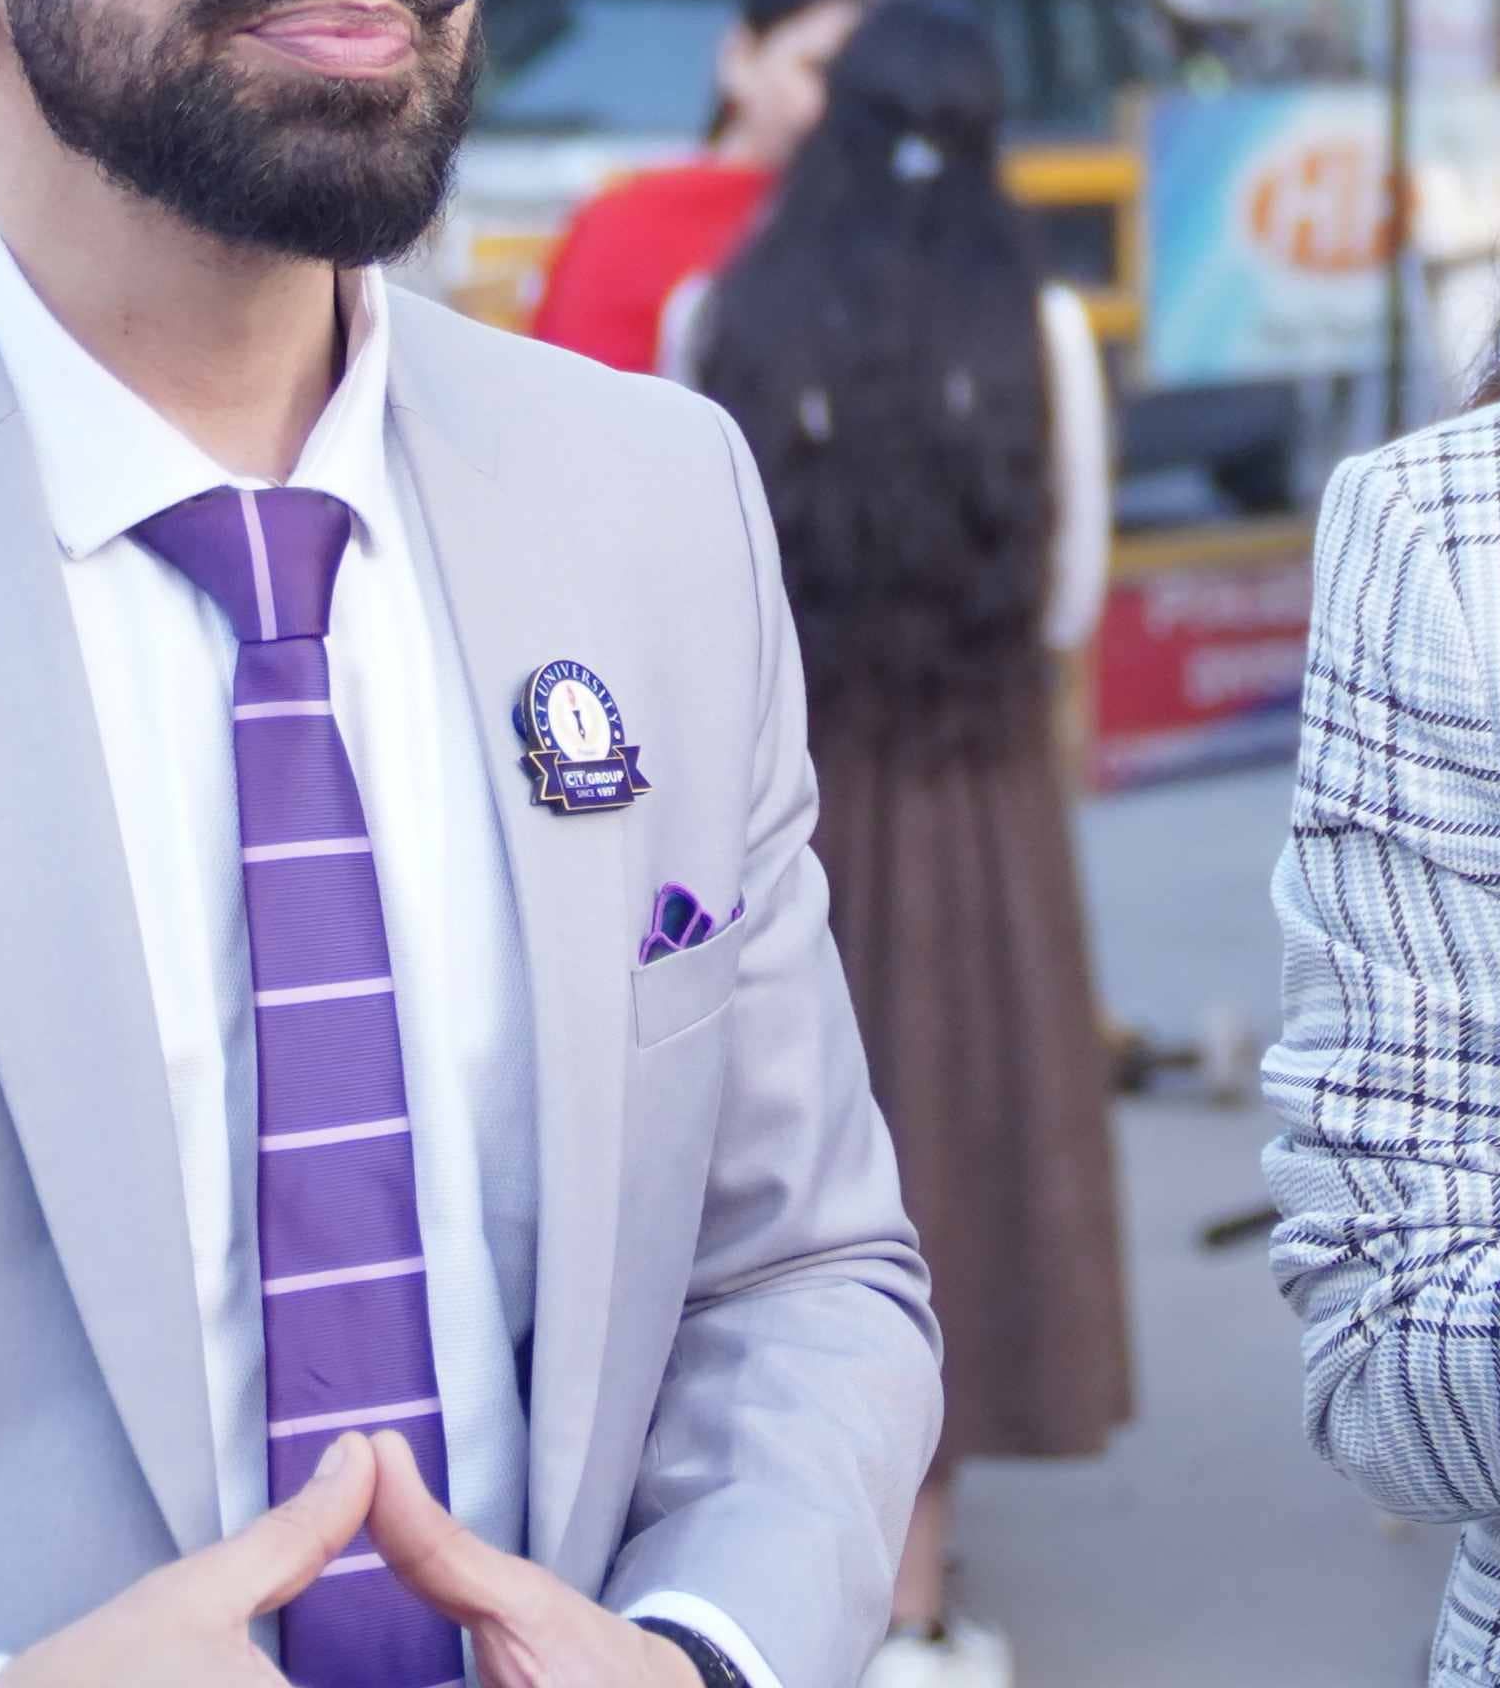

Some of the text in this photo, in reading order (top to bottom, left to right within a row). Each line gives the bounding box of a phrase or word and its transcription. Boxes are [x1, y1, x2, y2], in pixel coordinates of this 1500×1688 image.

[535, 662, 622, 732] CT UNIVERSITY
[586, 769, 625, 786] GROUP
